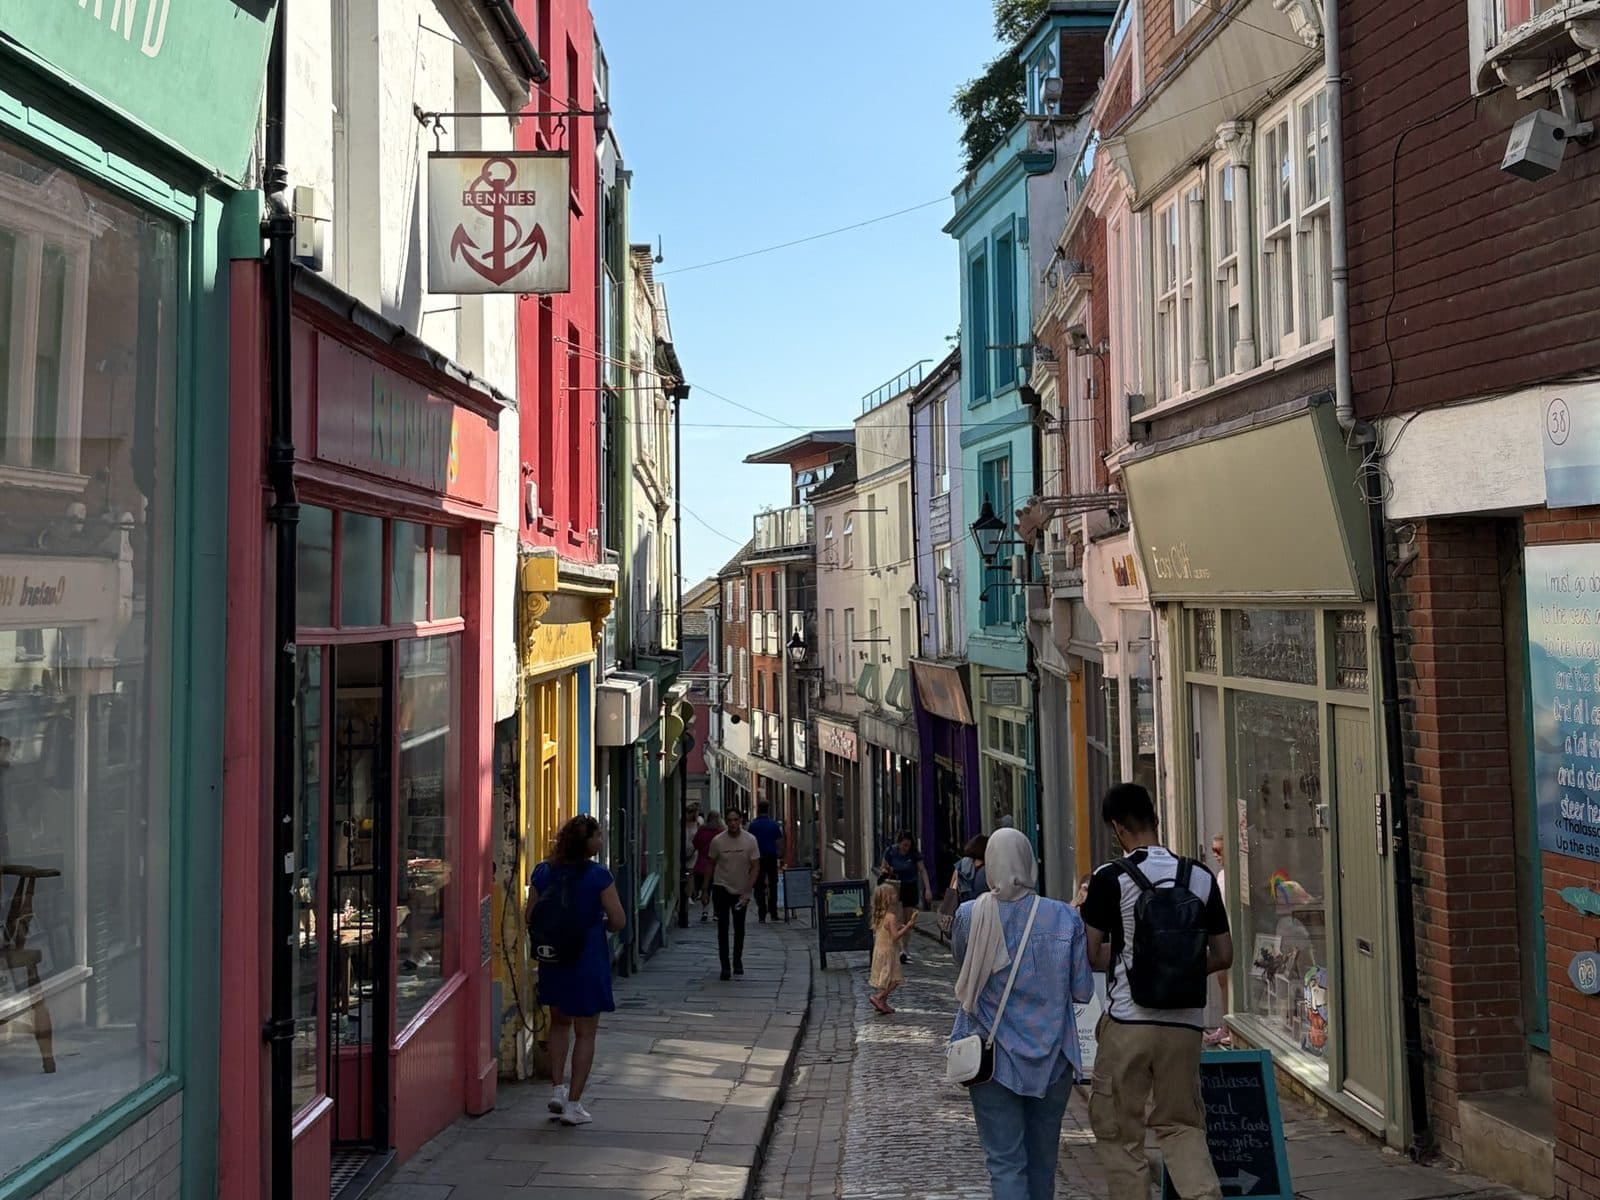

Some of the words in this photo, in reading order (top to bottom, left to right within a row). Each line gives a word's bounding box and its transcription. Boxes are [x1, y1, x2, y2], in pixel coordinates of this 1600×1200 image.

[78, 0, 170, 58] ND
[465, 192, 535, 204] RENNIES
[1552, 409, 1567, 434] 38
[1550, 569, 1572, 593] must
[1574, 576, 1587, 600] go
[1558, 763, 1576, 788] and
[1577, 769, 1585, 789] a
[1561, 793, 1585, 821] steer
[1556, 833, 1568, 853] Up
[1569, 838, 1585, 854] the
[1205, 1091, 1239, 1115] ocal
